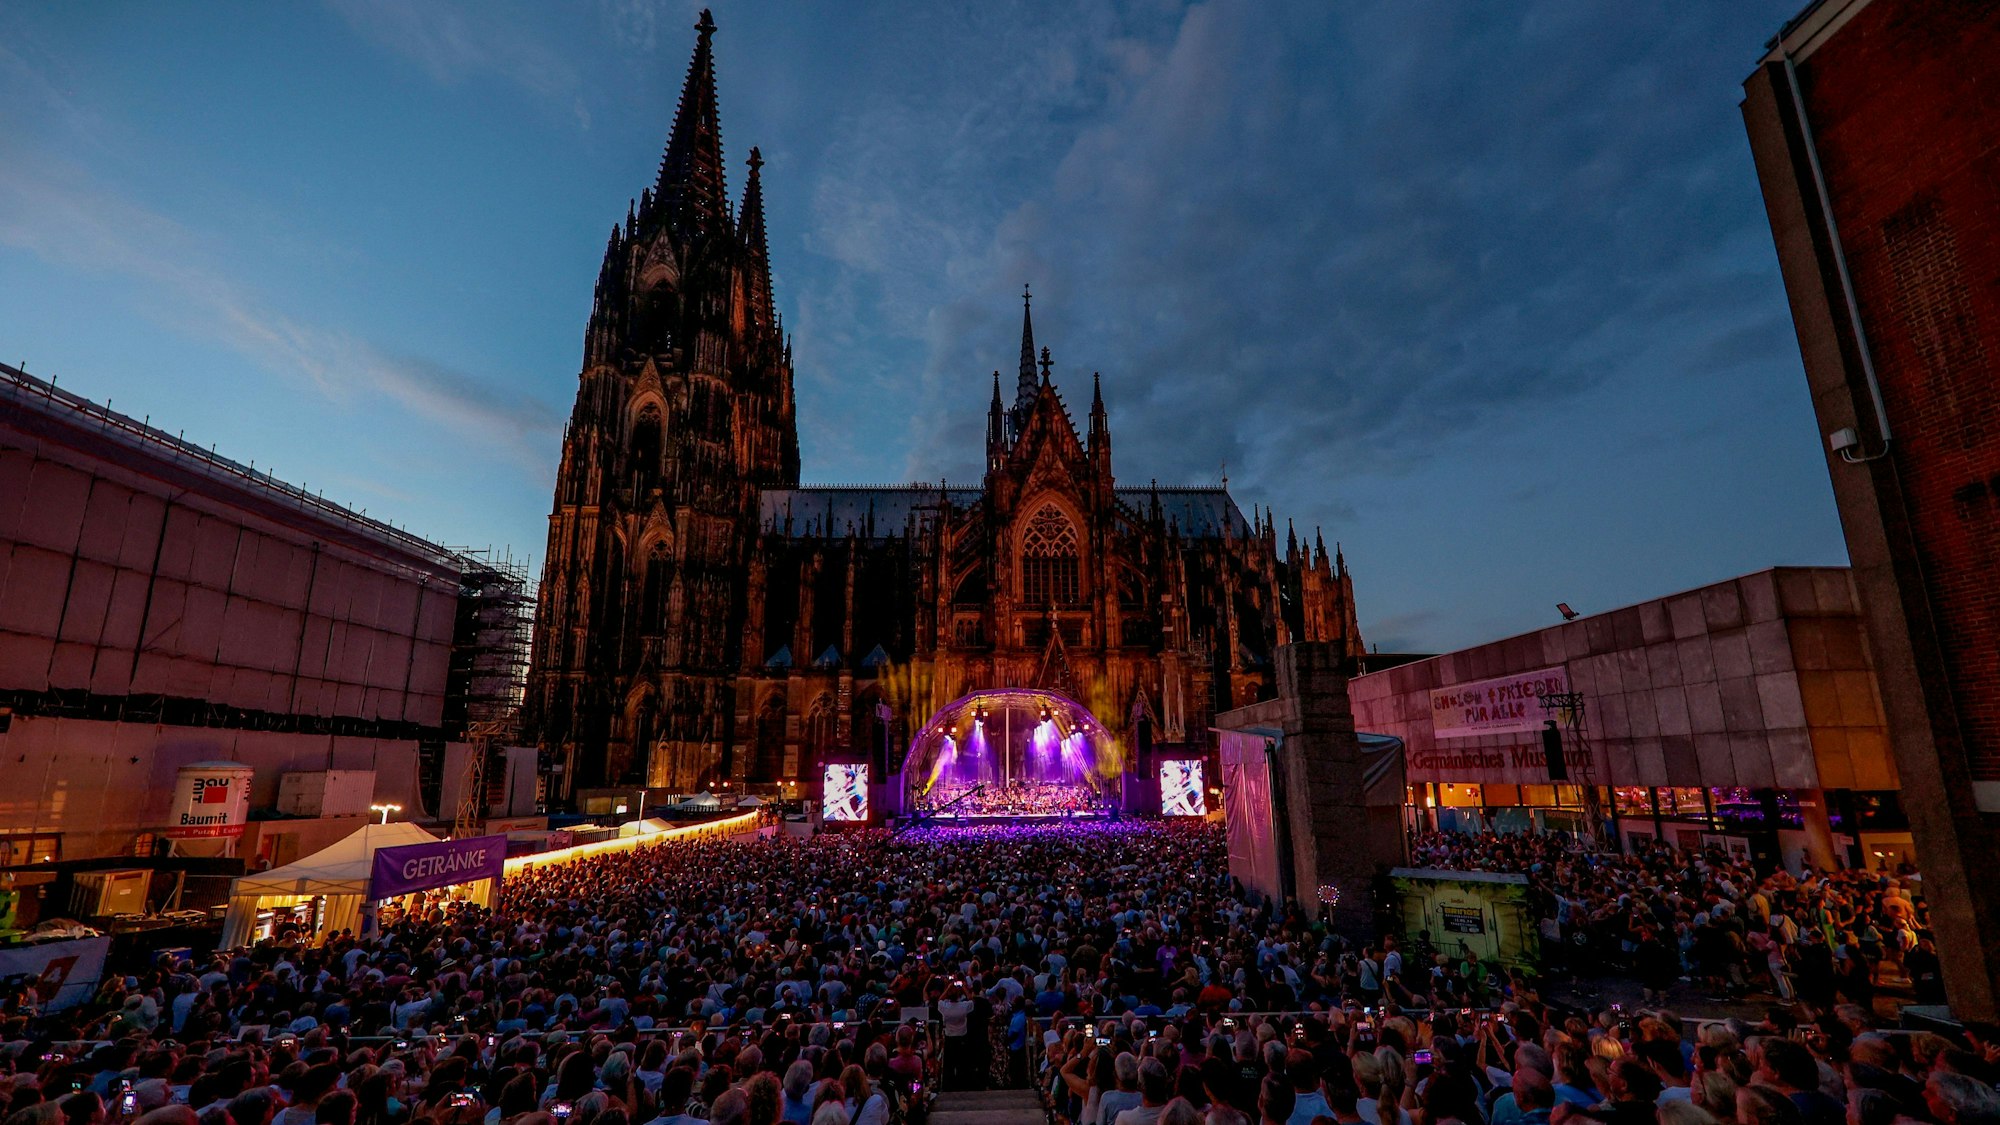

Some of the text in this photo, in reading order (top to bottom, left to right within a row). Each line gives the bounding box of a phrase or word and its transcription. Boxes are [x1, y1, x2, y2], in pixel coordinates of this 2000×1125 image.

[1510, 745, 1594, 769] Musum
[181, 812, 228, 825] Baumit
[402, 848, 486, 880] GETRÄNKE
